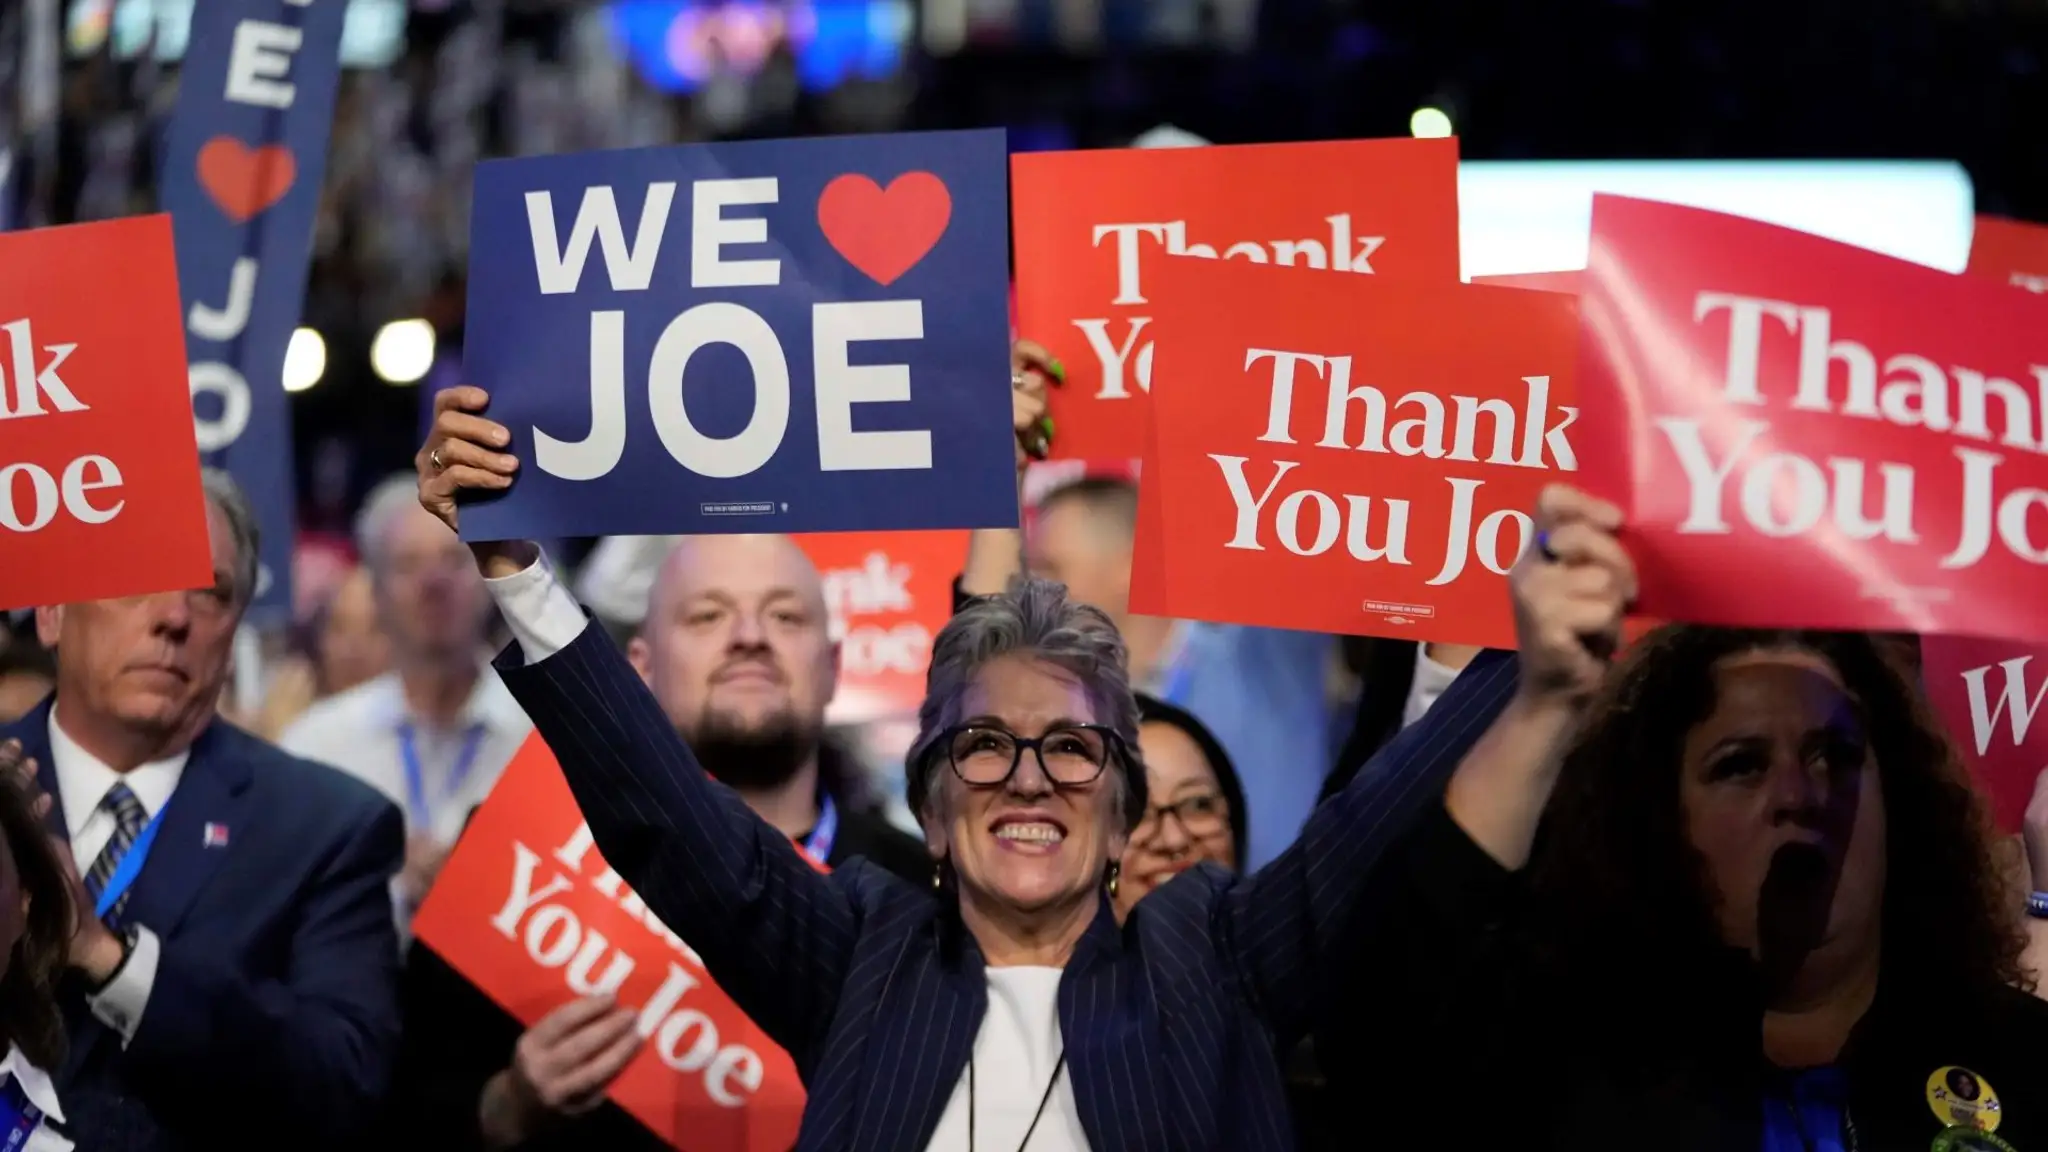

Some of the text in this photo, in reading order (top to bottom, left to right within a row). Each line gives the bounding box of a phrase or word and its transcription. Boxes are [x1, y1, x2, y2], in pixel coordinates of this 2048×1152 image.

[224, 0, 313, 110] E
[524, 177, 781, 294] WE
[0, 318, 91, 419] k
[532, 300, 933, 481] JOE
[1244, 348, 1579, 472] Thank
[1693, 290, 2048, 456] Than
[1207, 453, 1412, 566] You
[1655, 416, 1920, 546] You
[490, 839, 607, 998] You
[635, 961, 765, 1107] Joe
